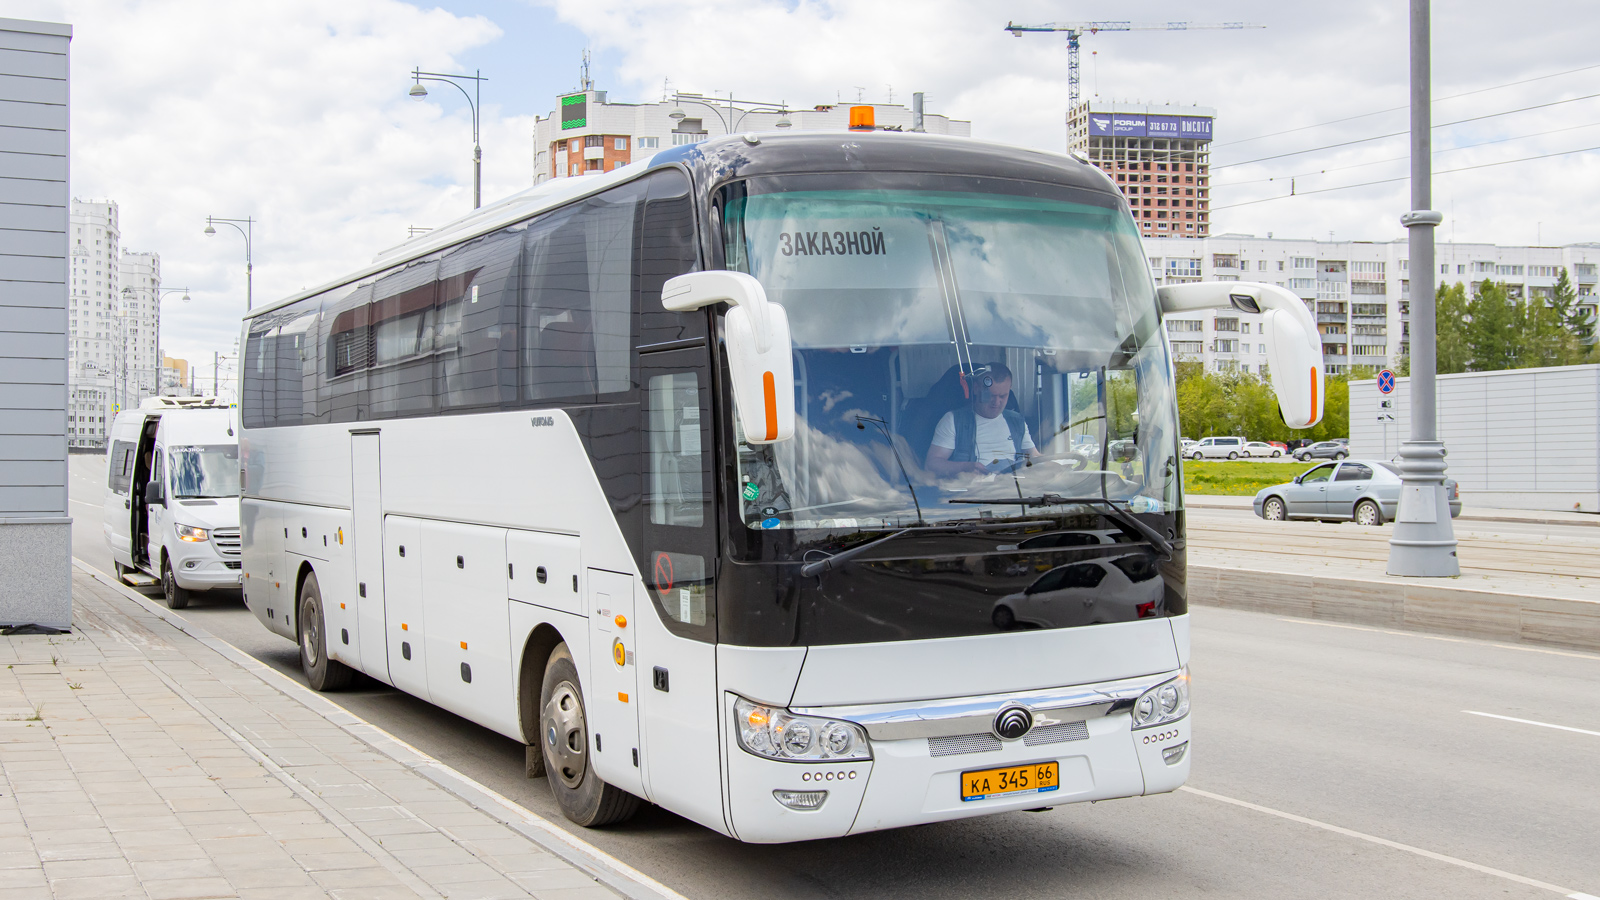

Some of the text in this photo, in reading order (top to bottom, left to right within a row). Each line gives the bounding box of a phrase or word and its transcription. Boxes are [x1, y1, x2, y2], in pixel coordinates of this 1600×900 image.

[1114, 119, 1146, 127] FORUM
[1149, 122, 1177, 132] 312 67 73
[779, 226, 886, 256] ЗАКАЗНОЙ
[998, 769, 1028, 790] 345
[1037, 765, 1052, 780] 66
